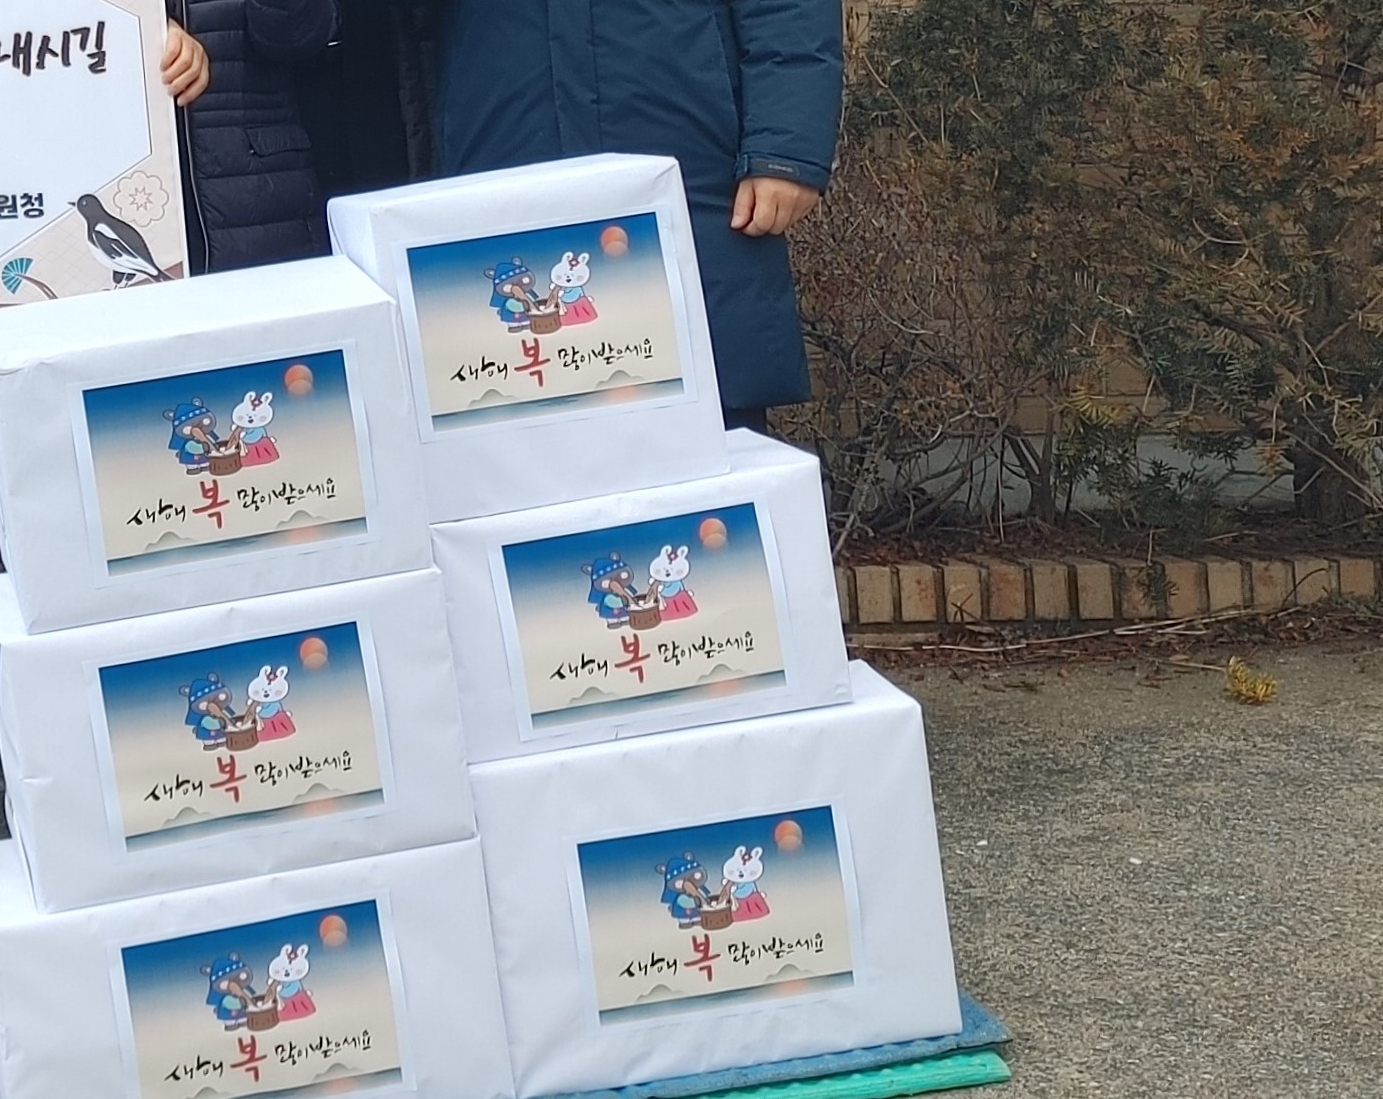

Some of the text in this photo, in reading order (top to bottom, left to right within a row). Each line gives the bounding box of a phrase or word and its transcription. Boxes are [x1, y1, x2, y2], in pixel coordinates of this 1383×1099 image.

[513, 337, 551, 388] 복
[192, 478, 231, 529] 복
[614, 632, 651, 684] 복
[209, 753, 248, 804] 복
[683, 933, 722, 983] 복
[229, 1034, 268, 1083] 복
